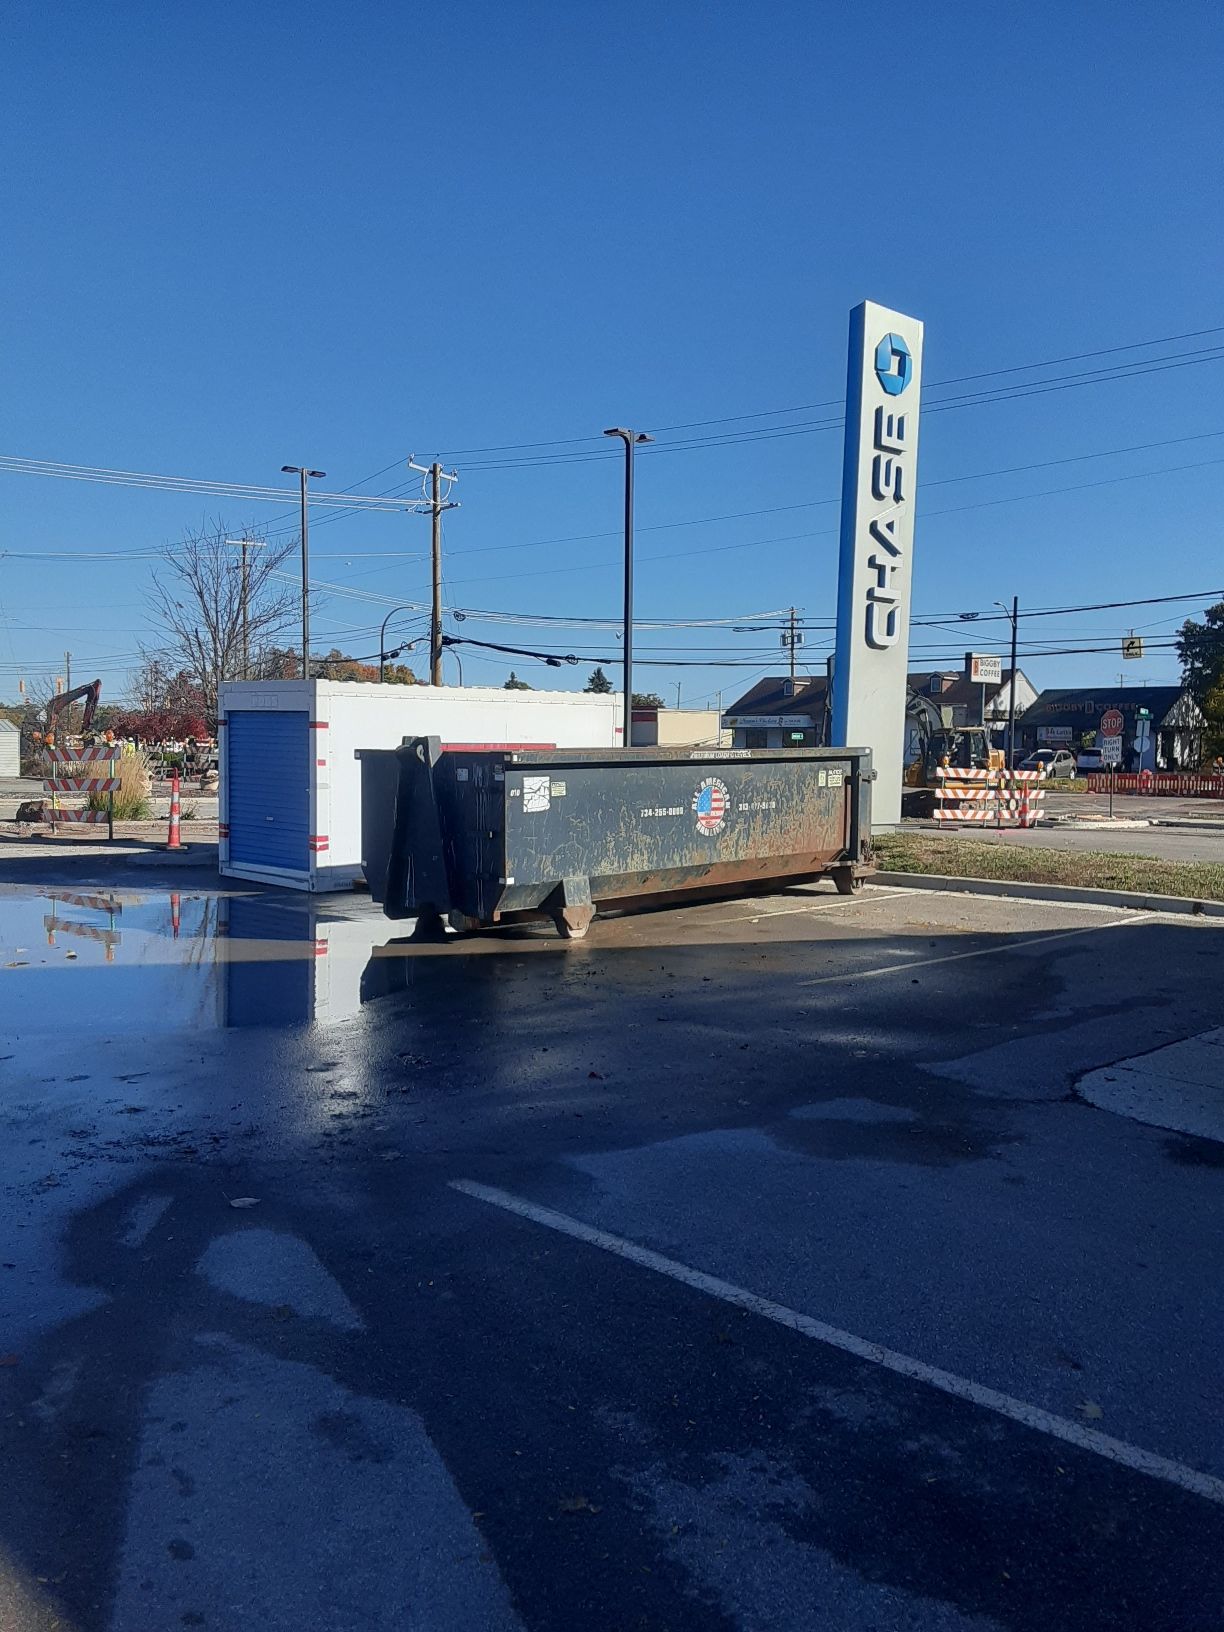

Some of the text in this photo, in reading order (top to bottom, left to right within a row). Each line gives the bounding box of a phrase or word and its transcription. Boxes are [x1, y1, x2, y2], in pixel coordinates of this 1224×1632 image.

[866, 405, 909, 650] CHASE
[980, 658, 1000, 668] BIGGBY
[980, 669, 1000, 678] COFFEE
[1102, 717, 1122, 729] STOP
[1104, 738, 1120, 746] RIGHT
[1104, 746, 1120, 754] TURN
[1104, 753, 1120, 761] ONLY
[700, 777, 731, 809] AMERICAN
[695, 820, 726, 836] HAULING
